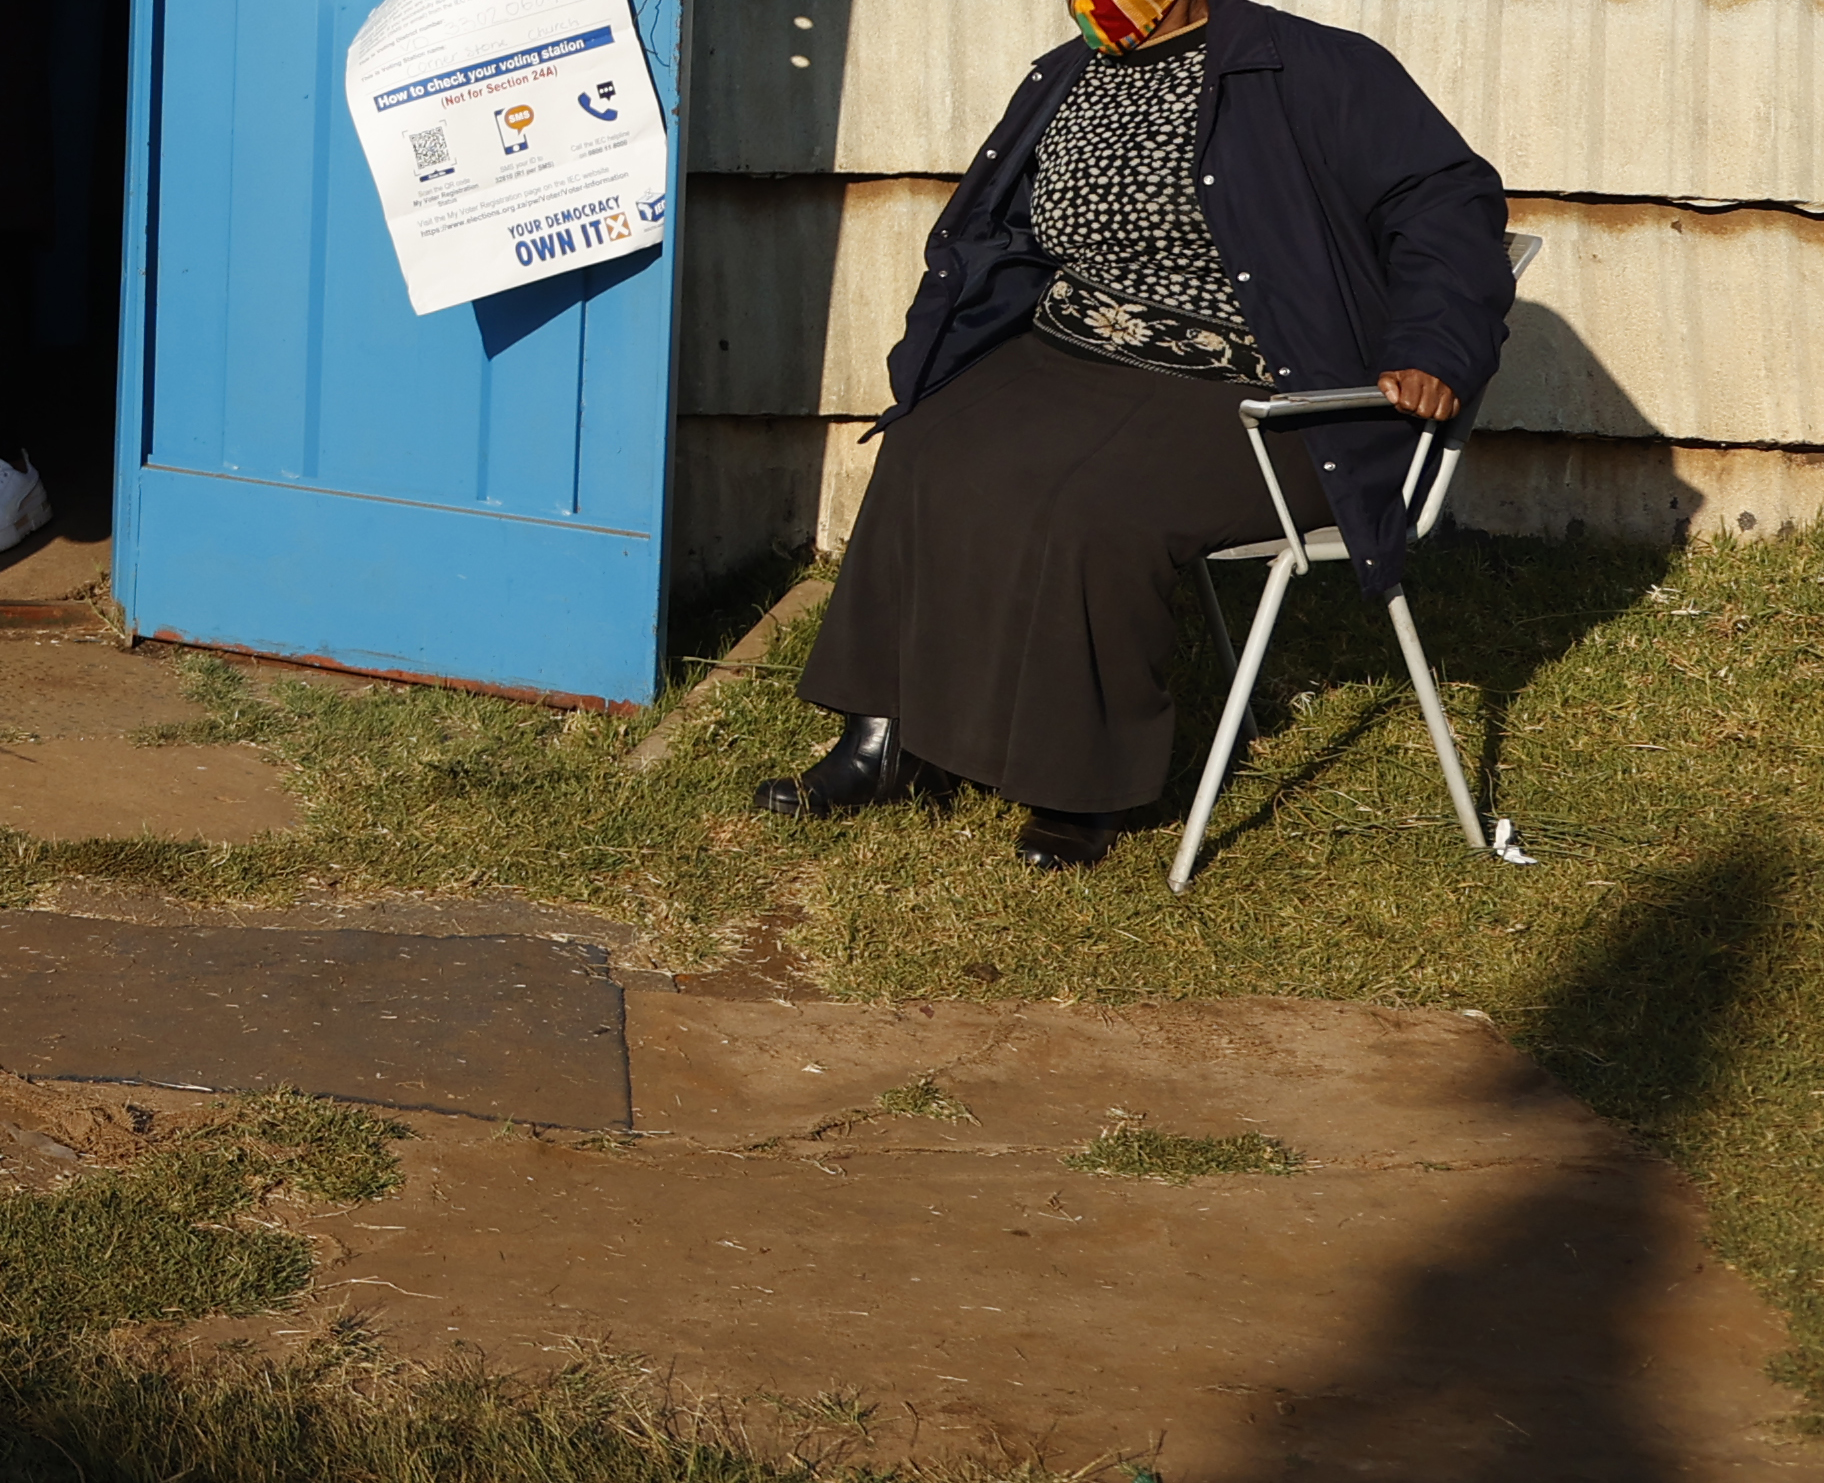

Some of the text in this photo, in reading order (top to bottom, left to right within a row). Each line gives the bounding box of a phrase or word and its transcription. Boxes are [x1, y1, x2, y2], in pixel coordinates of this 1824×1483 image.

[377, 38, 585, 109] How to check your voting station
[403, 51, 426, 64] Station
[441, 64, 559, 111] (Not for Section 24A)
[509, 109, 530, 124] SMS
[595, 136, 607, 145] IEC
[434, 214, 446, 224] the
[447, 211, 458, 222] My
[459, 203, 479, 216] Voter
[479, 191, 523, 210] Registration
[524, 185, 542, 198] page
[543, 182, 553, 191] on
[554, 177, 566, 187] the
[566, 174, 581, 184] IEC
[583, 166, 610, 180] website
[507, 194, 622, 240] YOUR DEMOCRACY
[515, 218, 604, 267] OWN IT
